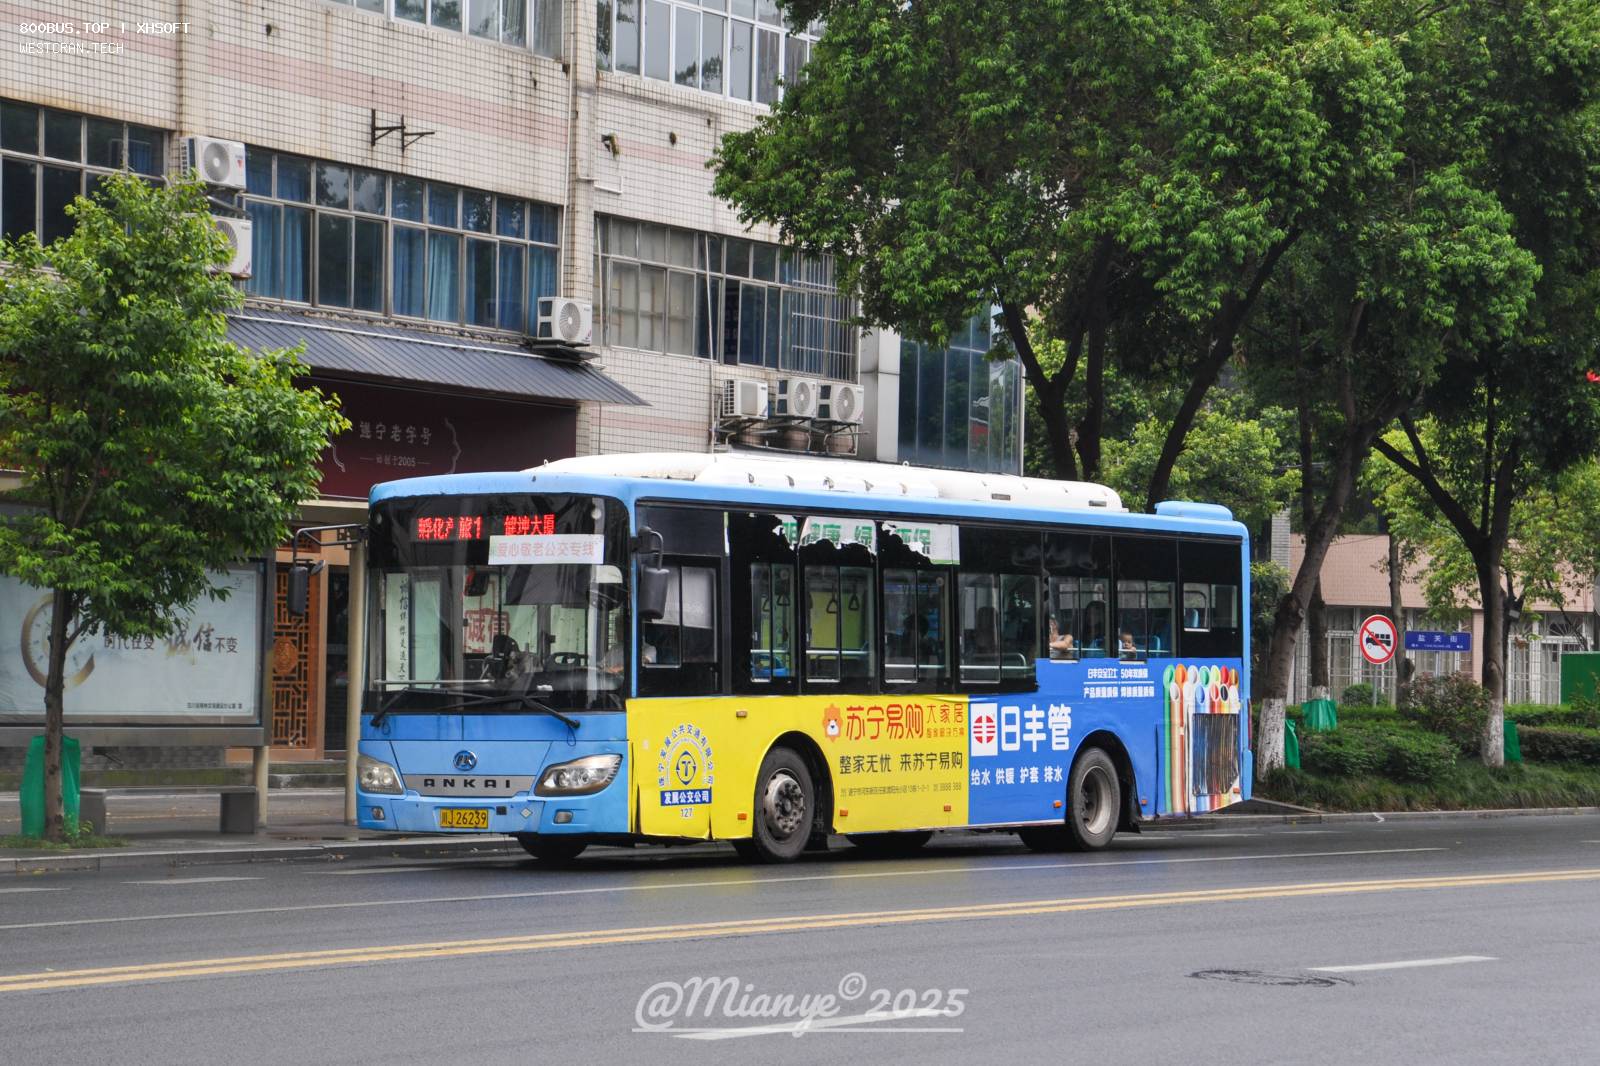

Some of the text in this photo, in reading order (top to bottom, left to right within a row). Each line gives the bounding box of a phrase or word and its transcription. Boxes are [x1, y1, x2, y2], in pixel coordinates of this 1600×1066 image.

[359, 420, 432, 446] 遂宁老字号
[497, 541, 595, 558] 爱心敬老公交专线
[846, 703, 964, 741] 苏宁易购 大家居
[1000, 703, 1072, 753] 日丰管
[839, 751, 963, 775] 整家无忧 来苏宁易购
[423, 778, 511, 789] ANKAI
[970, 765, 1063, 786] 给水 供暖 护套 排水
[664, 790, 710, 805] 发展公交公司
[680, 807, 693, 818] 127
